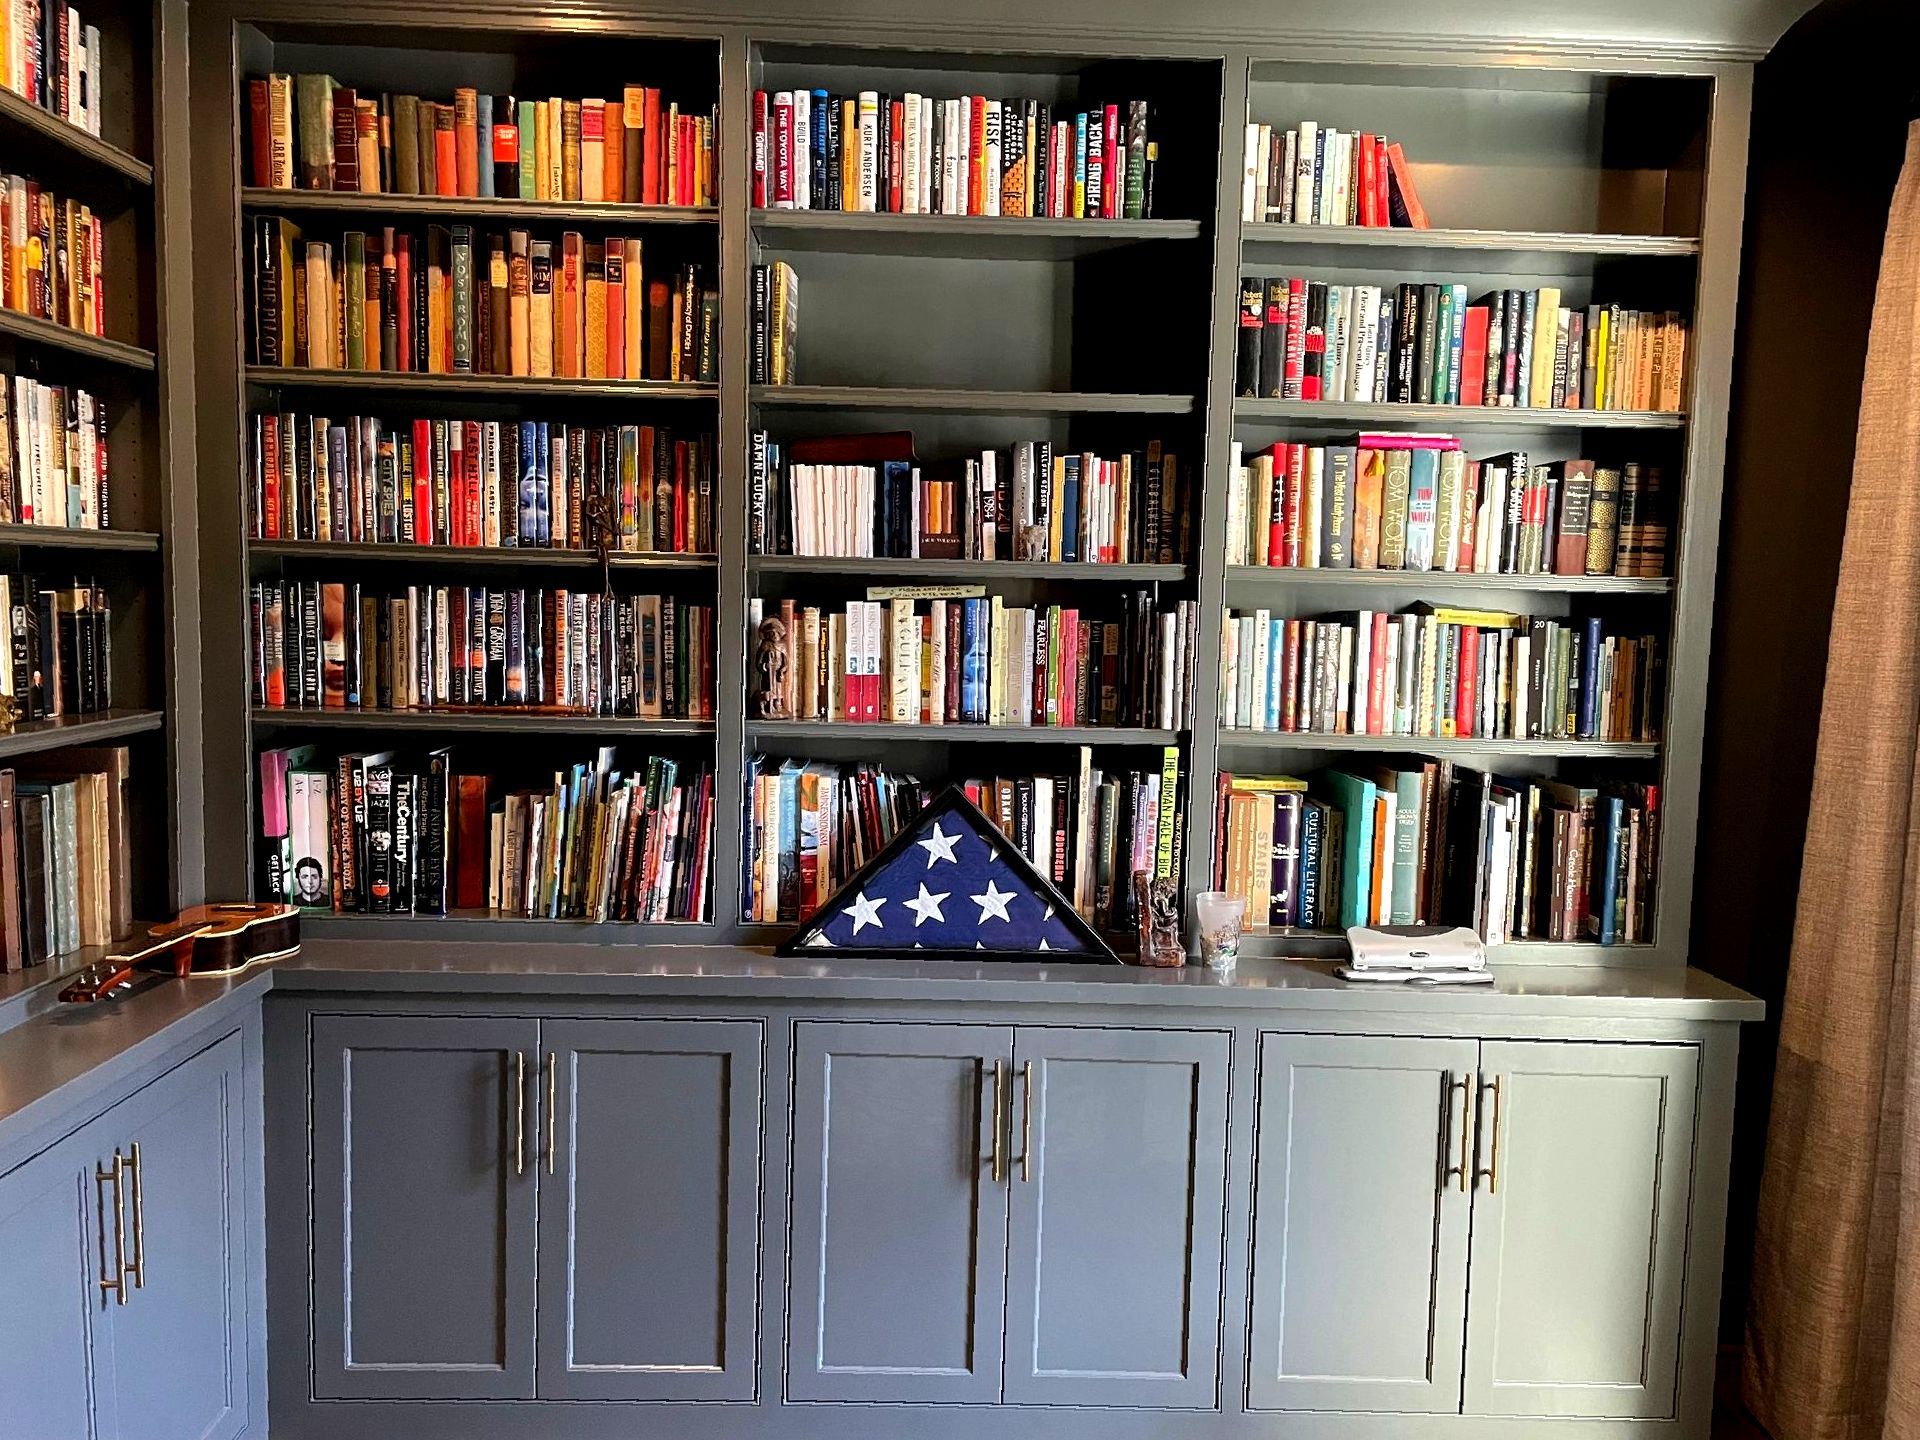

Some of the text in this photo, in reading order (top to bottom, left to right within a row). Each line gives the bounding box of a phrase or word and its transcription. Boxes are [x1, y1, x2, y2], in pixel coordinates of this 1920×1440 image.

[831, 100, 839, 122] What
[986, 112, 999, 146] RISK
[756, 132, 764, 171] FORWARD
[863, 124, 872, 197] KURT ANDERSEN
[1088, 122, 1102, 206] FIRING BACK
[2, 225, 10, 292] EINSTEIN
[533, 272, 551, 282] KIM
[262, 266, 276, 362] THE PILOT
[457, 253, 467, 352] NOSTROMO
[1376, 352, 1387, 379] Patriot
[1555, 338, 1567, 385] MIDDLESEX
[1653, 339, 1662, 358] LIFE
[381, 459, 393, 516] CITY SPIES
[468, 464, 478, 496] HILL
[753, 434, 763, 517] DAMN LUCKY
[1512, 455, 1526, 476] JOHN
[403, 504, 413, 540] LOST CITY
[983, 496, 995, 518] 1984
[1384, 466, 1406, 556] TOM WOLFE
[510, 592, 520, 612] JOHN
[490, 592, 504, 660] JOHN GRISHAM
[664, 603, 674, 664] ROCK CONCERT
[1036, 619, 1046, 665] FEARLESS
[899, 628, 911, 672] GULF
[295, 779, 304, 795] A-K
[339, 758, 347, 805] HISTORY
[1002, 787, 1011, 822] OBAMA
[340, 806, 348, 820] OF
[394, 781, 411, 863] The Century
[819, 787, 829, 846] IMPRESSIONISM
[1146, 800, 1156, 846] NEW YORK
[1159, 756, 1176, 874] THE HUMAN FACE OF BIG
[341, 822, 350, 852] ROCK
[768, 844, 776, 865] WEST
[271, 854, 280, 893] GET BACK
[343, 862, 353, 889] ROLL
[1256, 831, 1268, 890] STAIRS
[1305, 811, 1319, 924] CULTURAL LITERACY
[1566, 849, 1578, 911] Creole Houses
